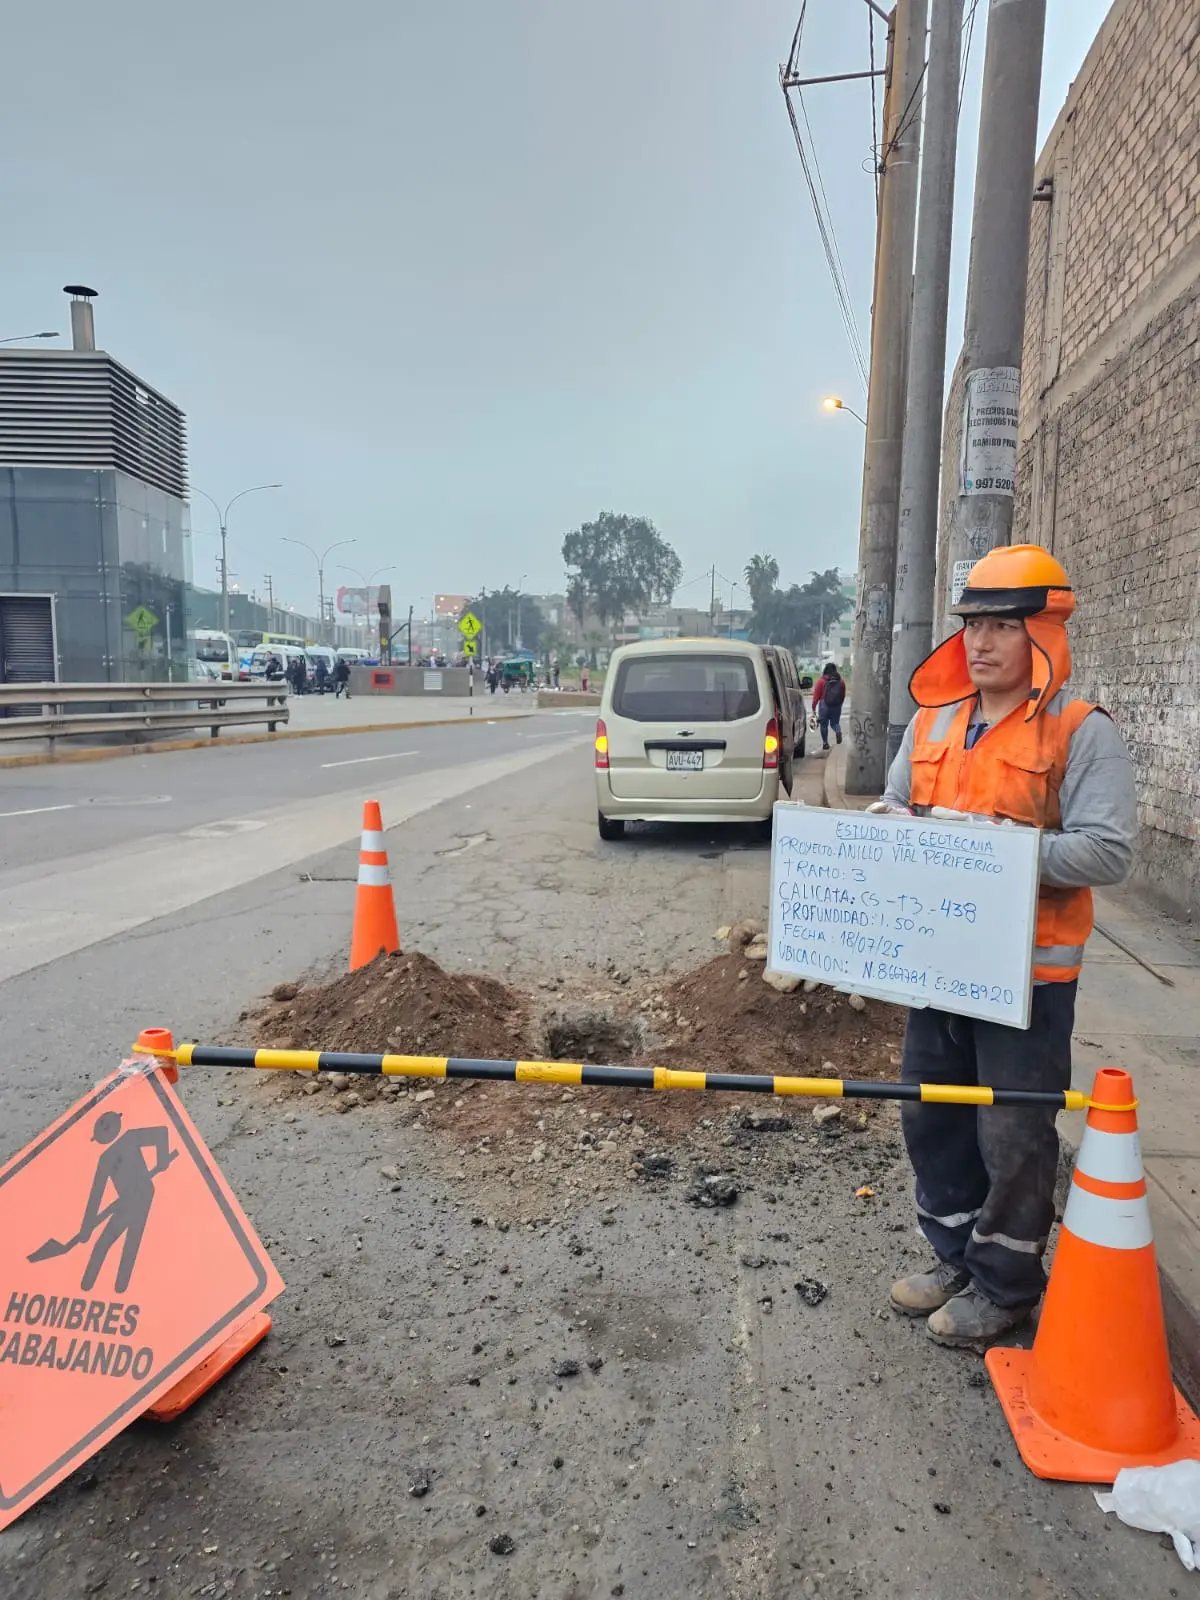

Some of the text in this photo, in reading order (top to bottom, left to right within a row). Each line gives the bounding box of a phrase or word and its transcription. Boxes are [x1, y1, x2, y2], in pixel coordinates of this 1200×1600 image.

[975, 477, 994, 489] 997
[836, 821, 994, 854] ESTUDIO DE GEOTECNIA
[838, 843, 883, 862] ANILLO
[892, 846, 920, 863] VIAL
[922, 849, 1004, 874] PERIFERICO
[851, 868, 867, 882] 3
[779, 881, 856, 905] CALICATA:
[778, 940, 848, 974] UBICACION:
[840, 930, 904, 958] 18/07/25
[4, 1292, 140, 1337] HOMBRES
